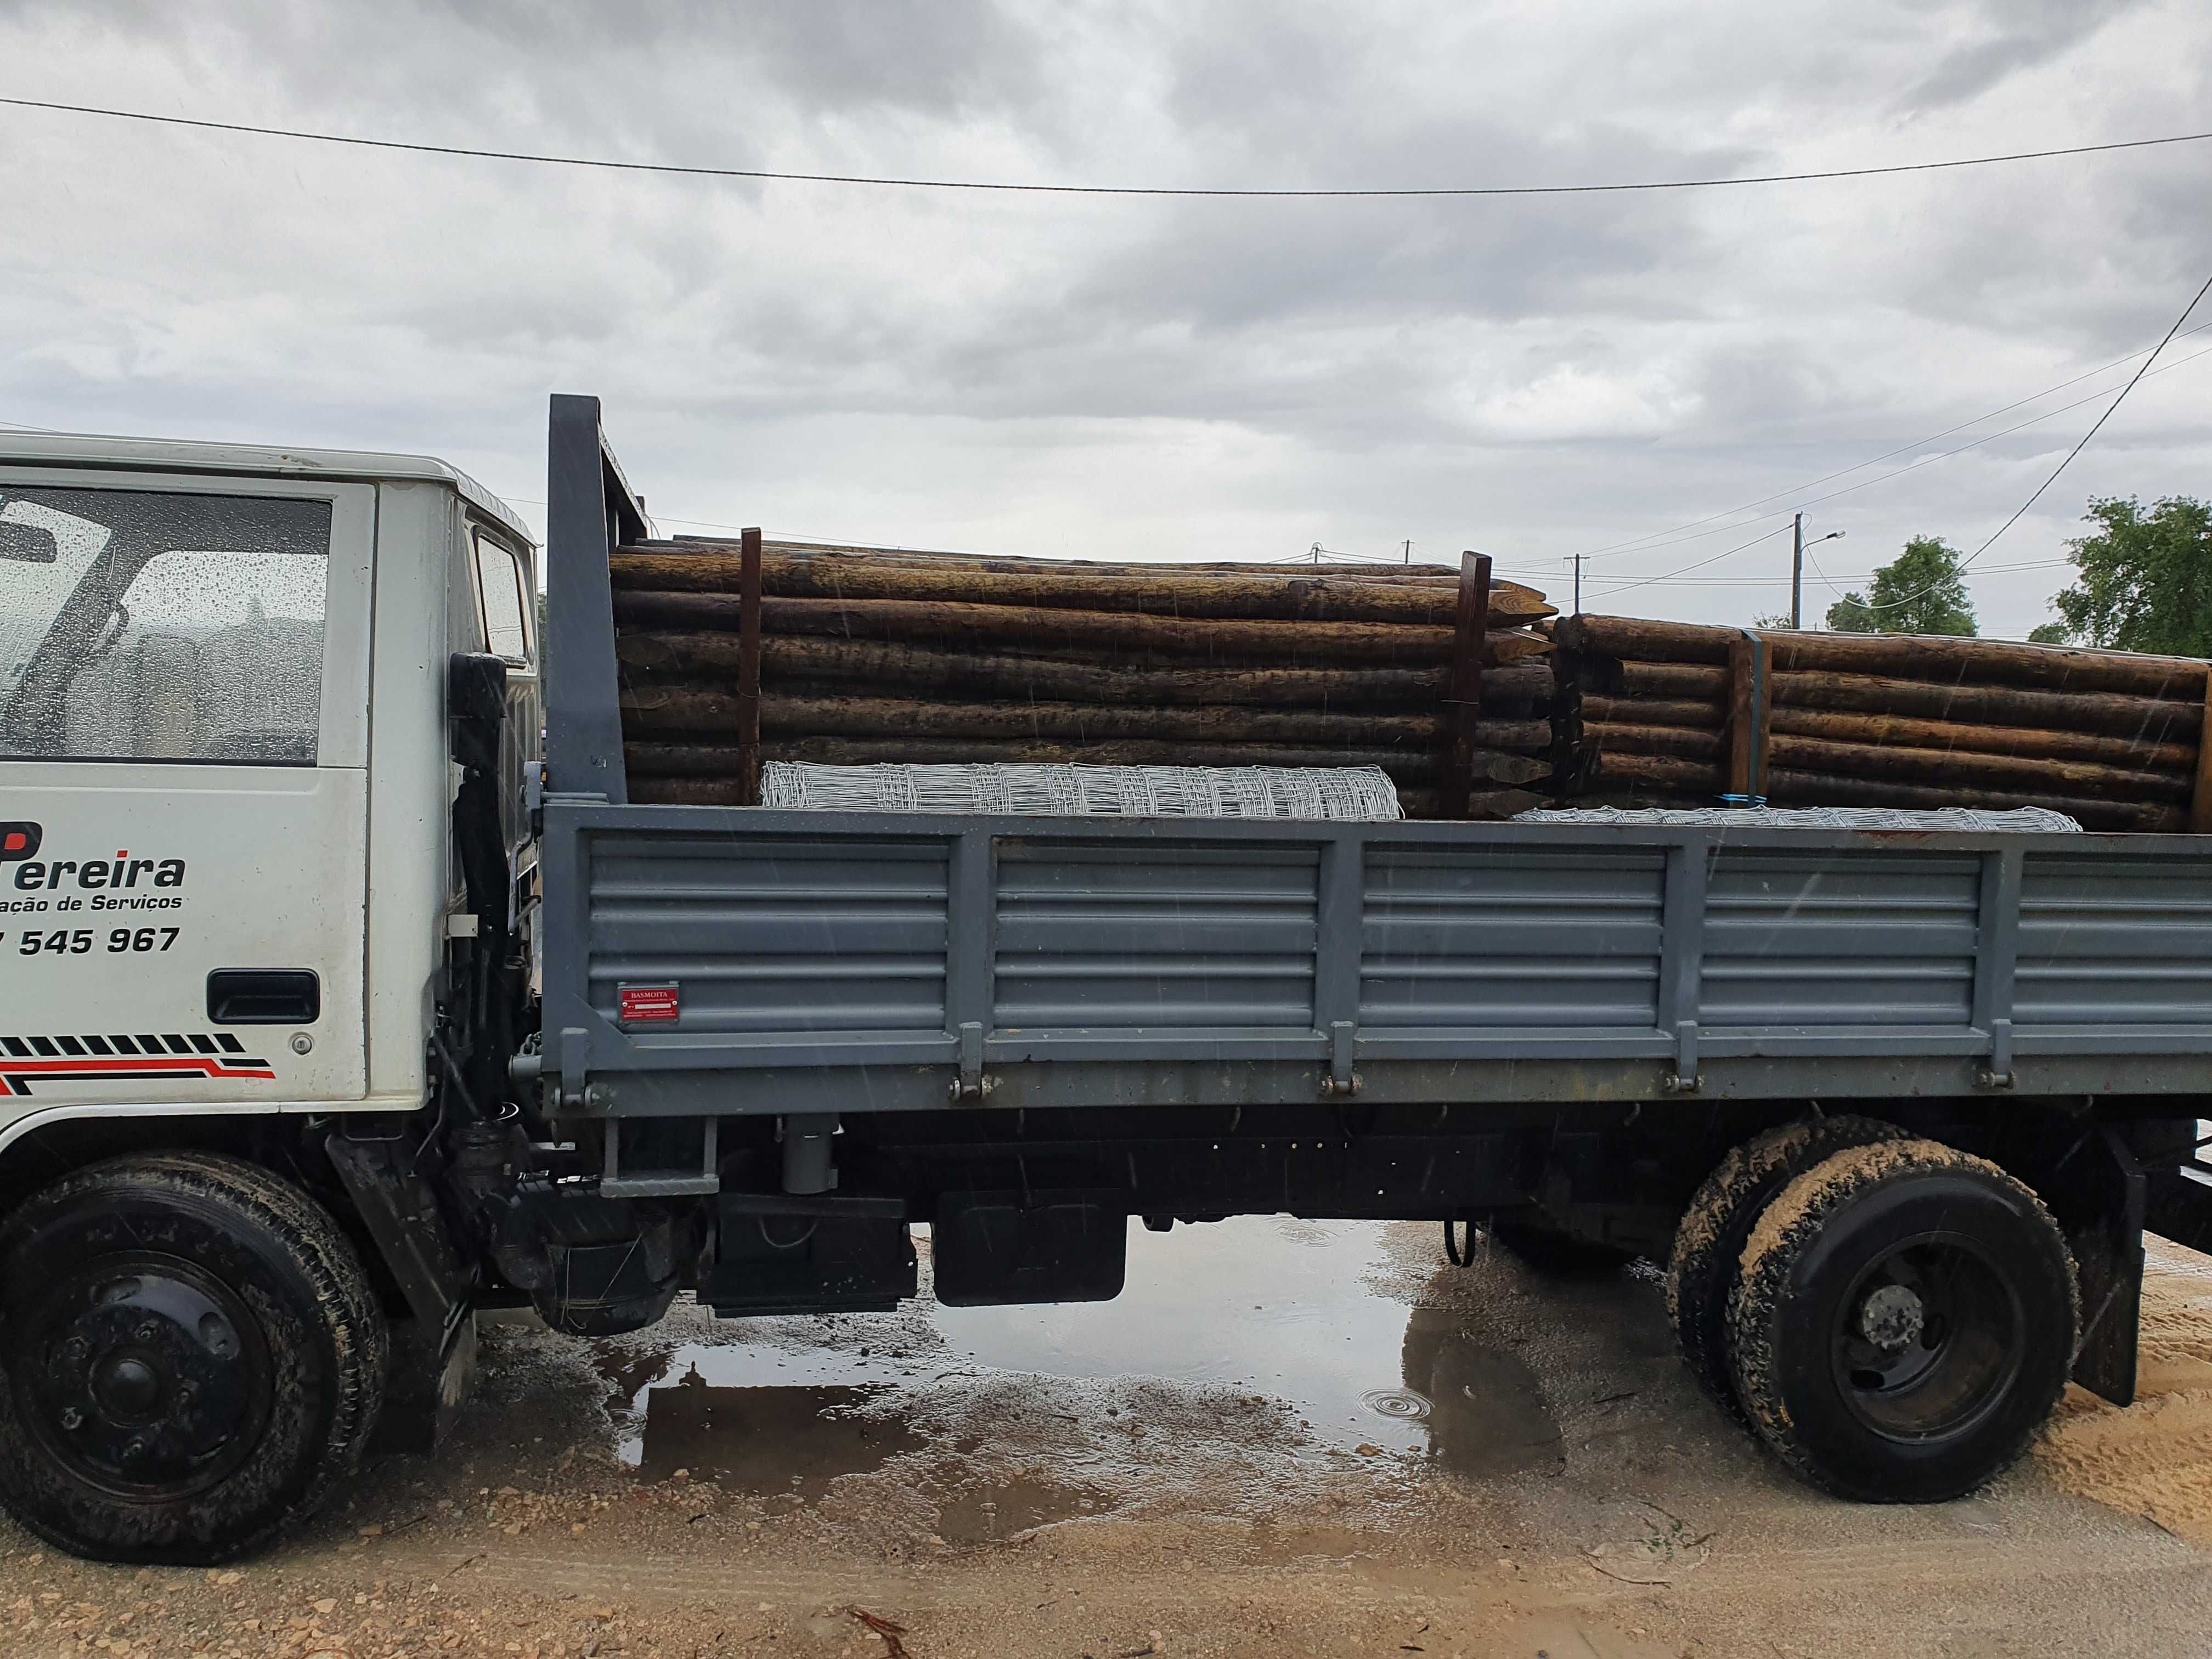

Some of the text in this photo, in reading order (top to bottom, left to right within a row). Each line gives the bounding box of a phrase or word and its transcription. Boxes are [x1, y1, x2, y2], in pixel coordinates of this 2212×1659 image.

[57, 896, 82, 911] de
[91, 894, 182, 912] Serviços
[19, 930, 93, 955] 545
[108, 928, 180, 952] 967
